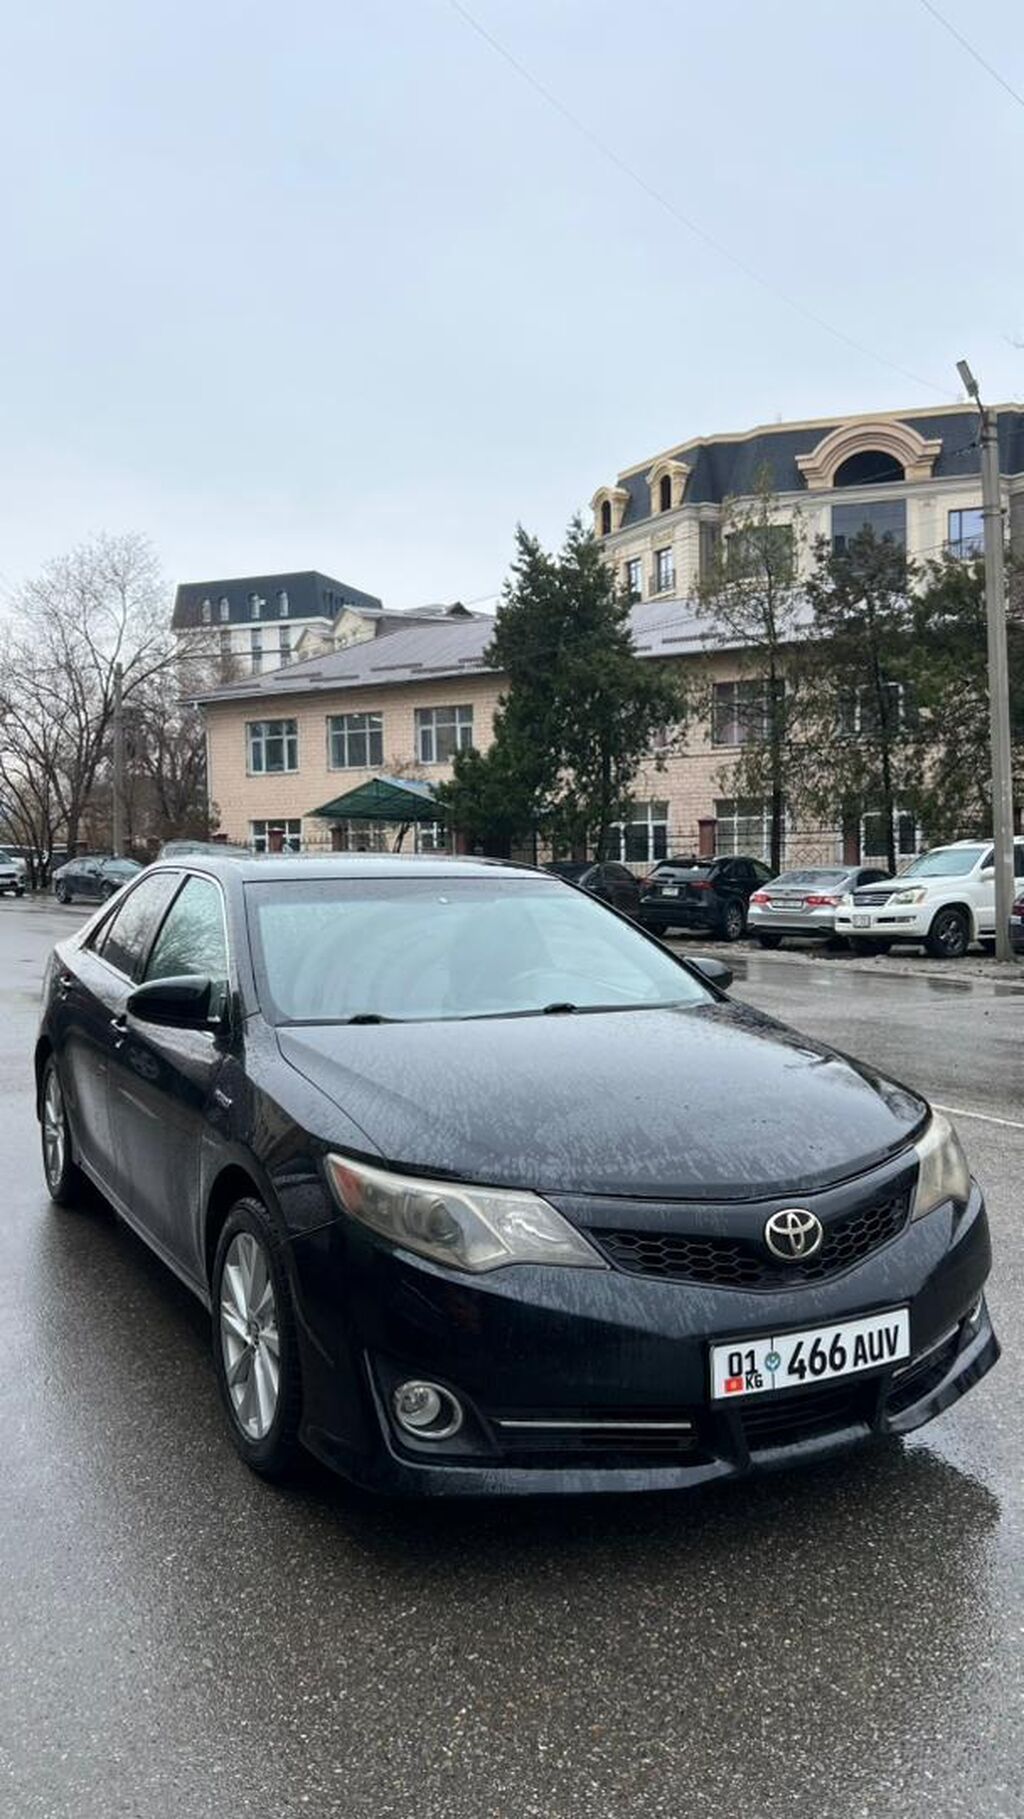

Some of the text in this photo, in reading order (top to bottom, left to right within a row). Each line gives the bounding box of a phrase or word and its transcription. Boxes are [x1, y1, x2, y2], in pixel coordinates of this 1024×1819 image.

[728, 1325, 900, 1379] 01 466 AUV
[745, 1374, 764, 1389] KG
